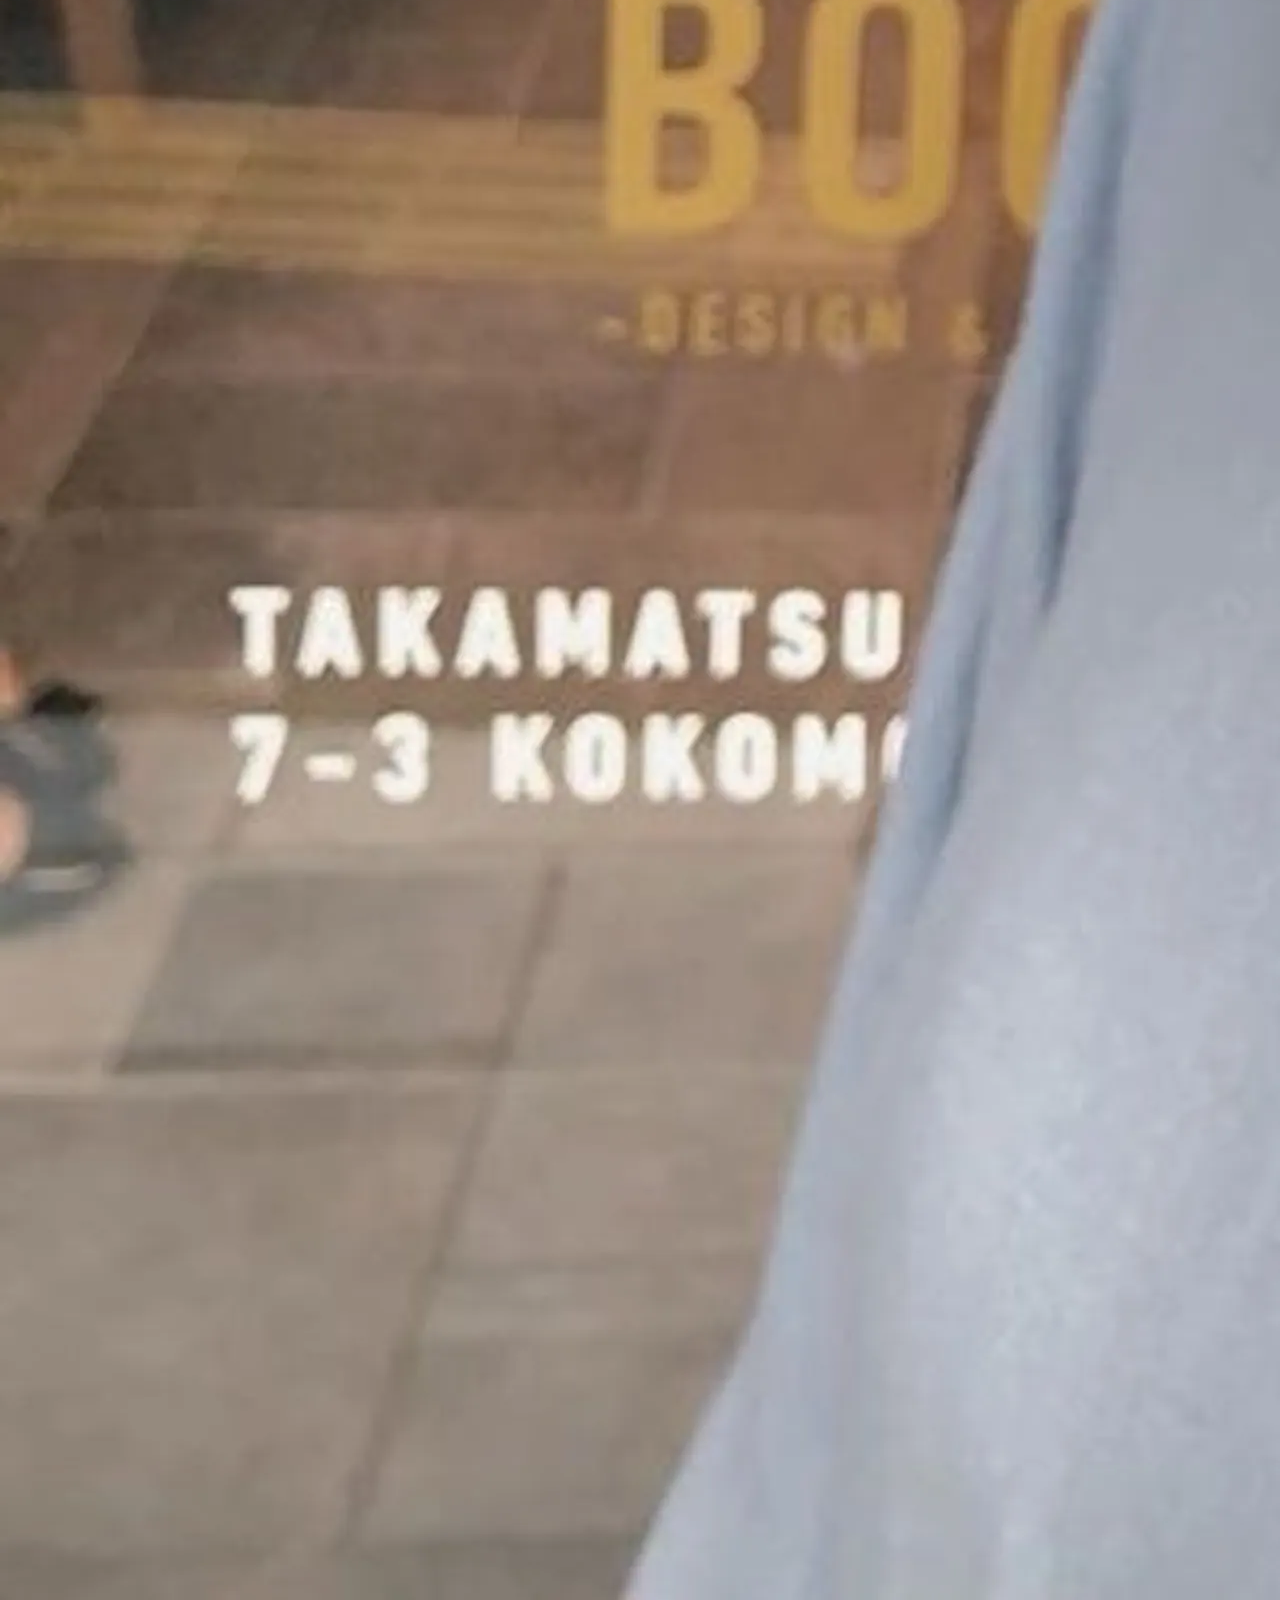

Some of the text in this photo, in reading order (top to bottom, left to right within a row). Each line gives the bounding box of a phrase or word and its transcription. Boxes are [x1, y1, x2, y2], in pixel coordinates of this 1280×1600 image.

[228, 585, 906, 683] TAKAMATSU
[229, 710, 910, 805] 7-3 KOKOM
